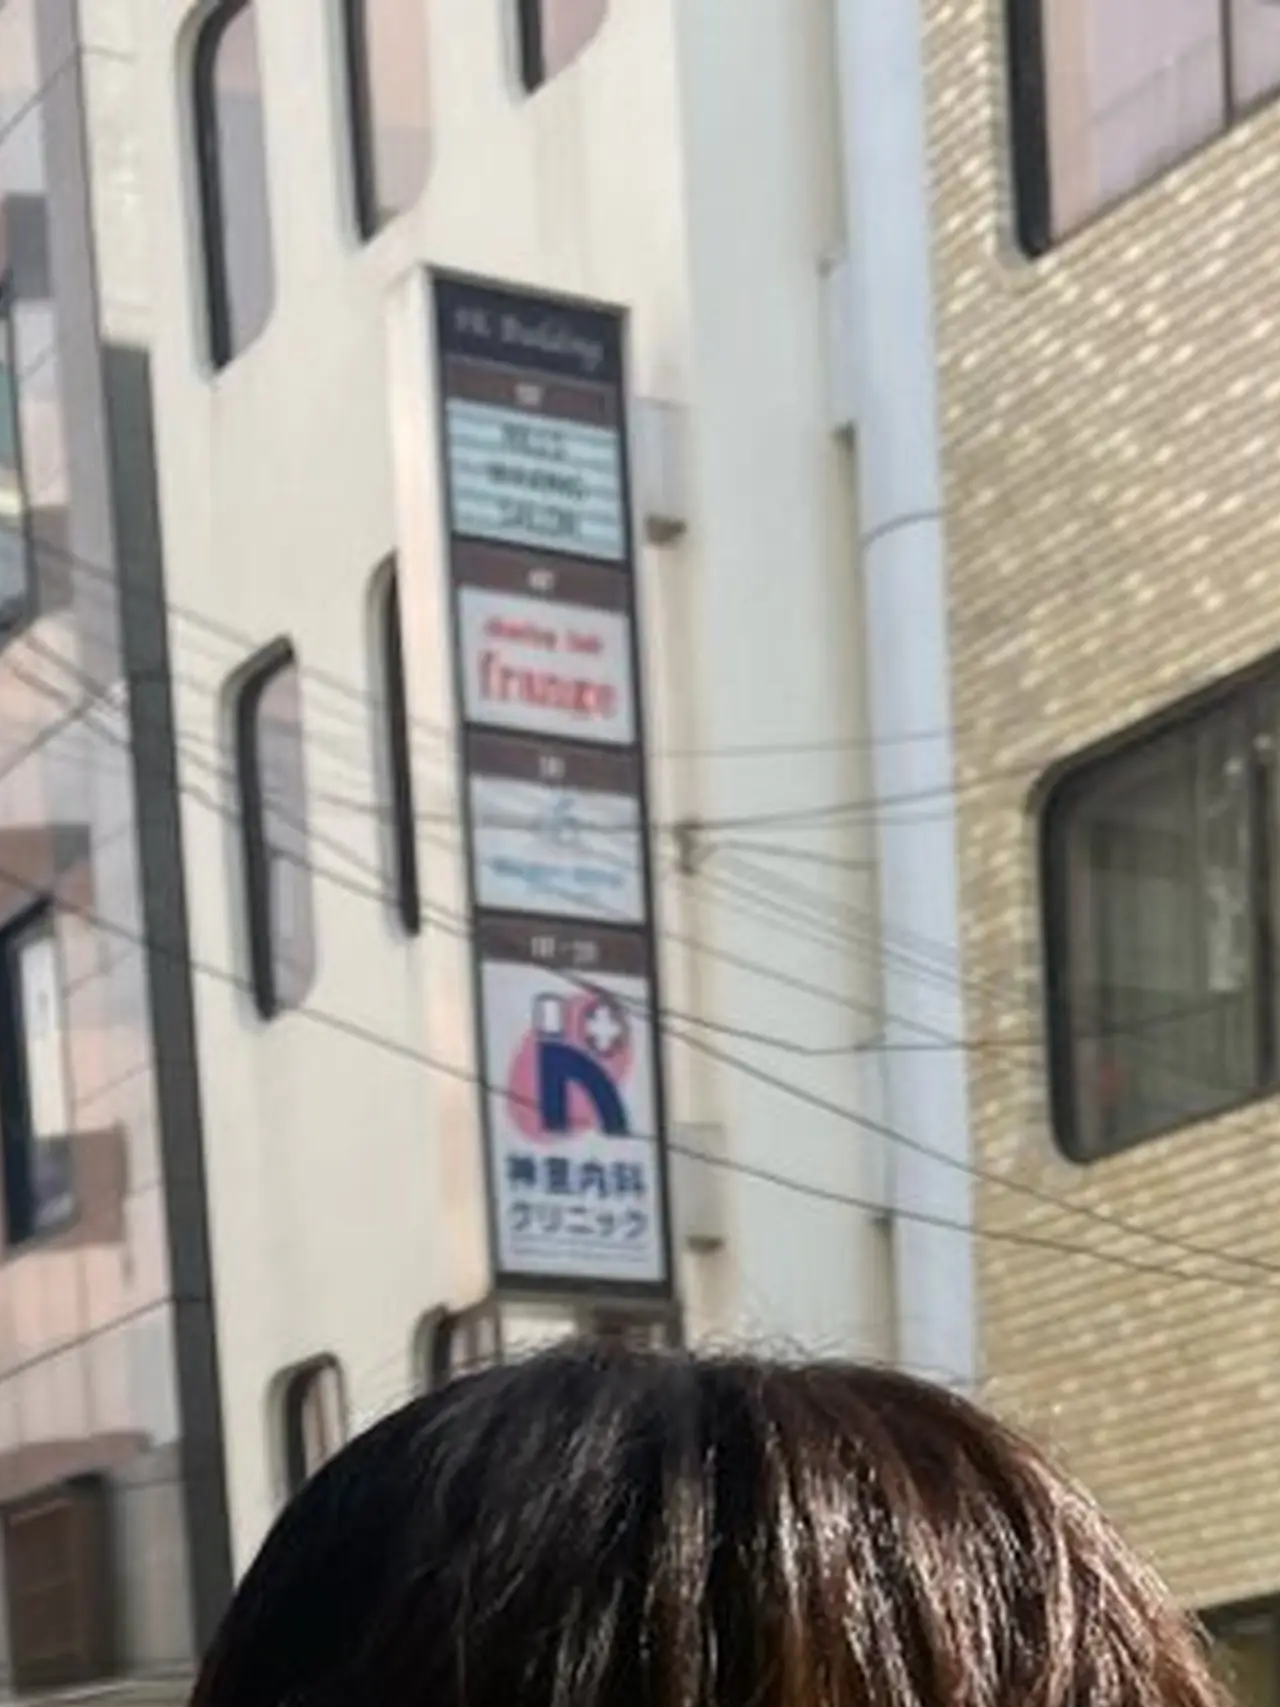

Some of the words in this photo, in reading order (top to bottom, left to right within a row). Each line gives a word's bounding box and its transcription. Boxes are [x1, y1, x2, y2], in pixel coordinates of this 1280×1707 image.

[508, 1200, 650, 1240] クリニック
